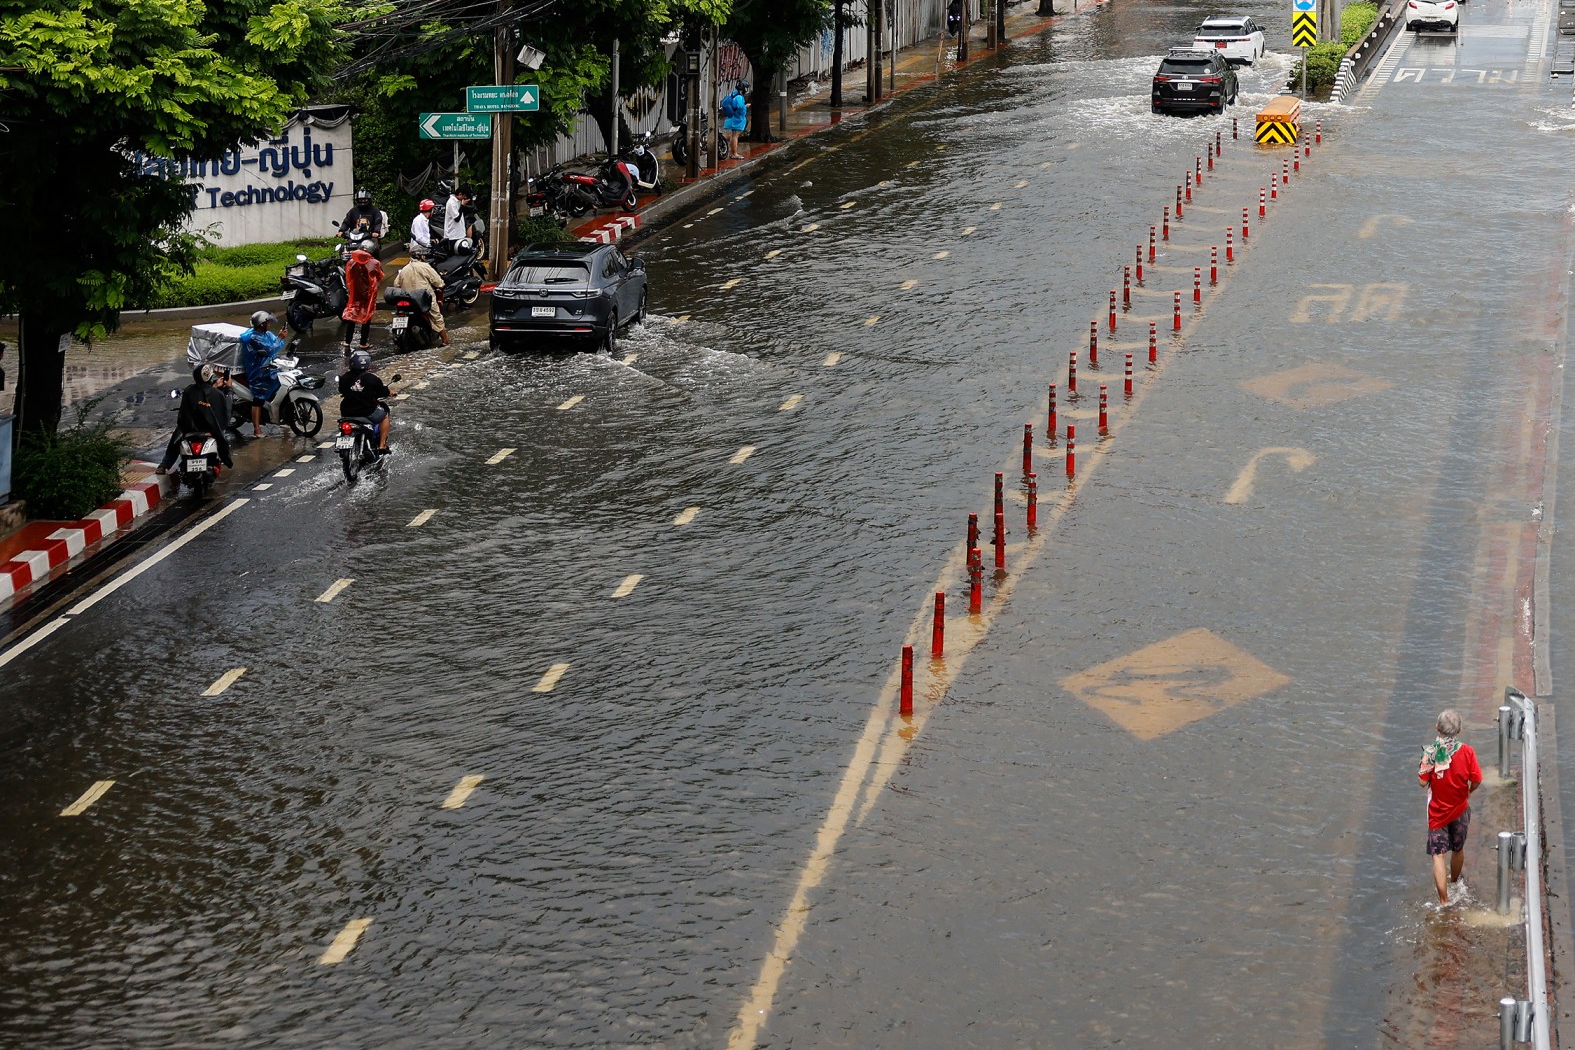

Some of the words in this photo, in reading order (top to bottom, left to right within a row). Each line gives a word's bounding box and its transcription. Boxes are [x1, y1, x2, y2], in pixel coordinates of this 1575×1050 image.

[1393, 68, 1518, 84] ความ
[206, 180, 334, 209] Technology
[1288, 283, 1408, 324] ลด
